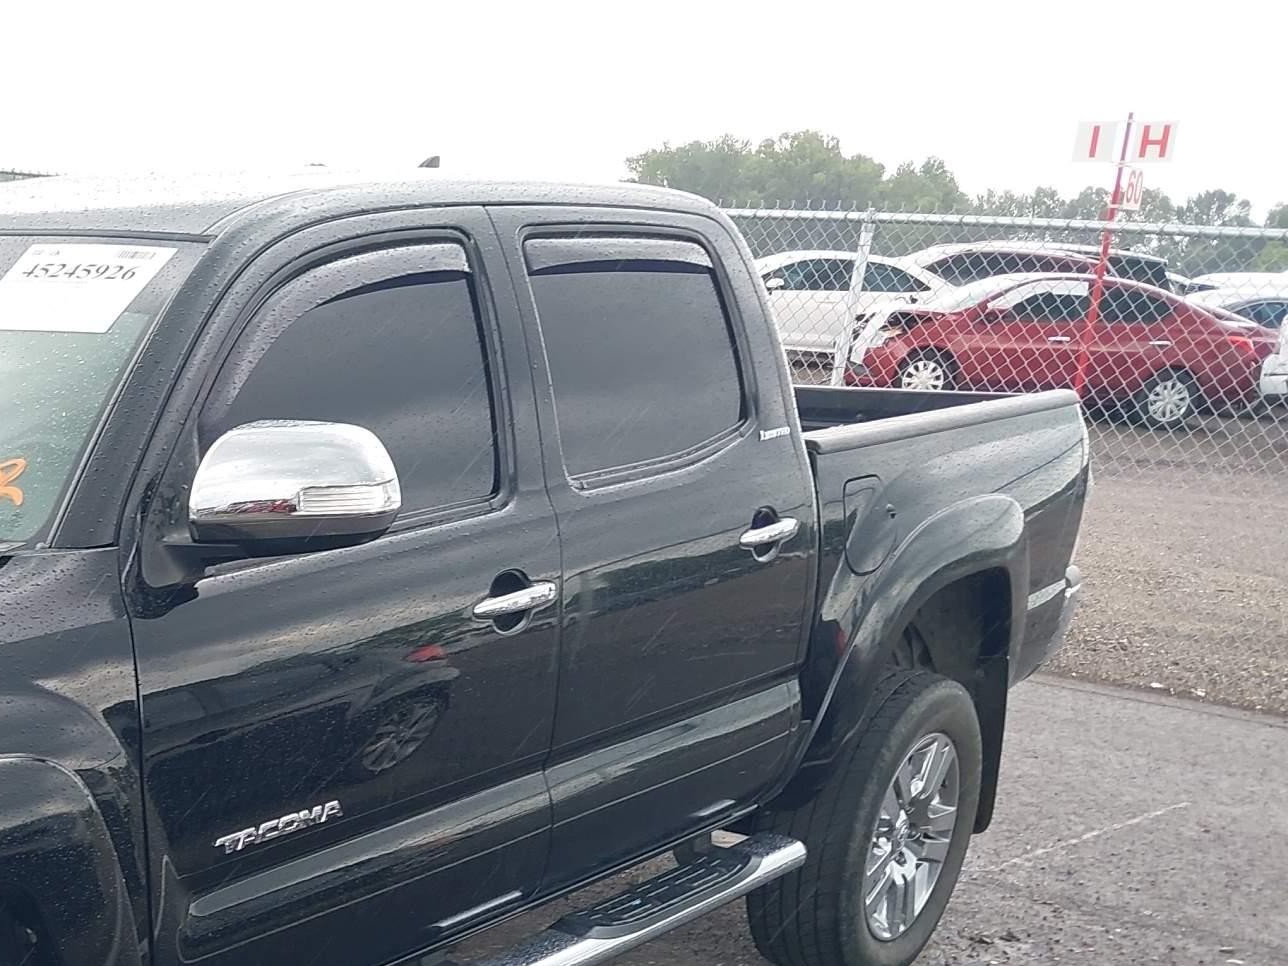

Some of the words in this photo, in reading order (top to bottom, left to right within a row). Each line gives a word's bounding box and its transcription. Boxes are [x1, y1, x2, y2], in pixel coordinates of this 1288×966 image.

[1088, 125, 1101, 158] I
[1138, 124, 1171, 158] H
[1125, 169, 1144, 204] 60
[21, 263, 141, 281] 45245926
[213, 799, 344, 855] TACOMA
